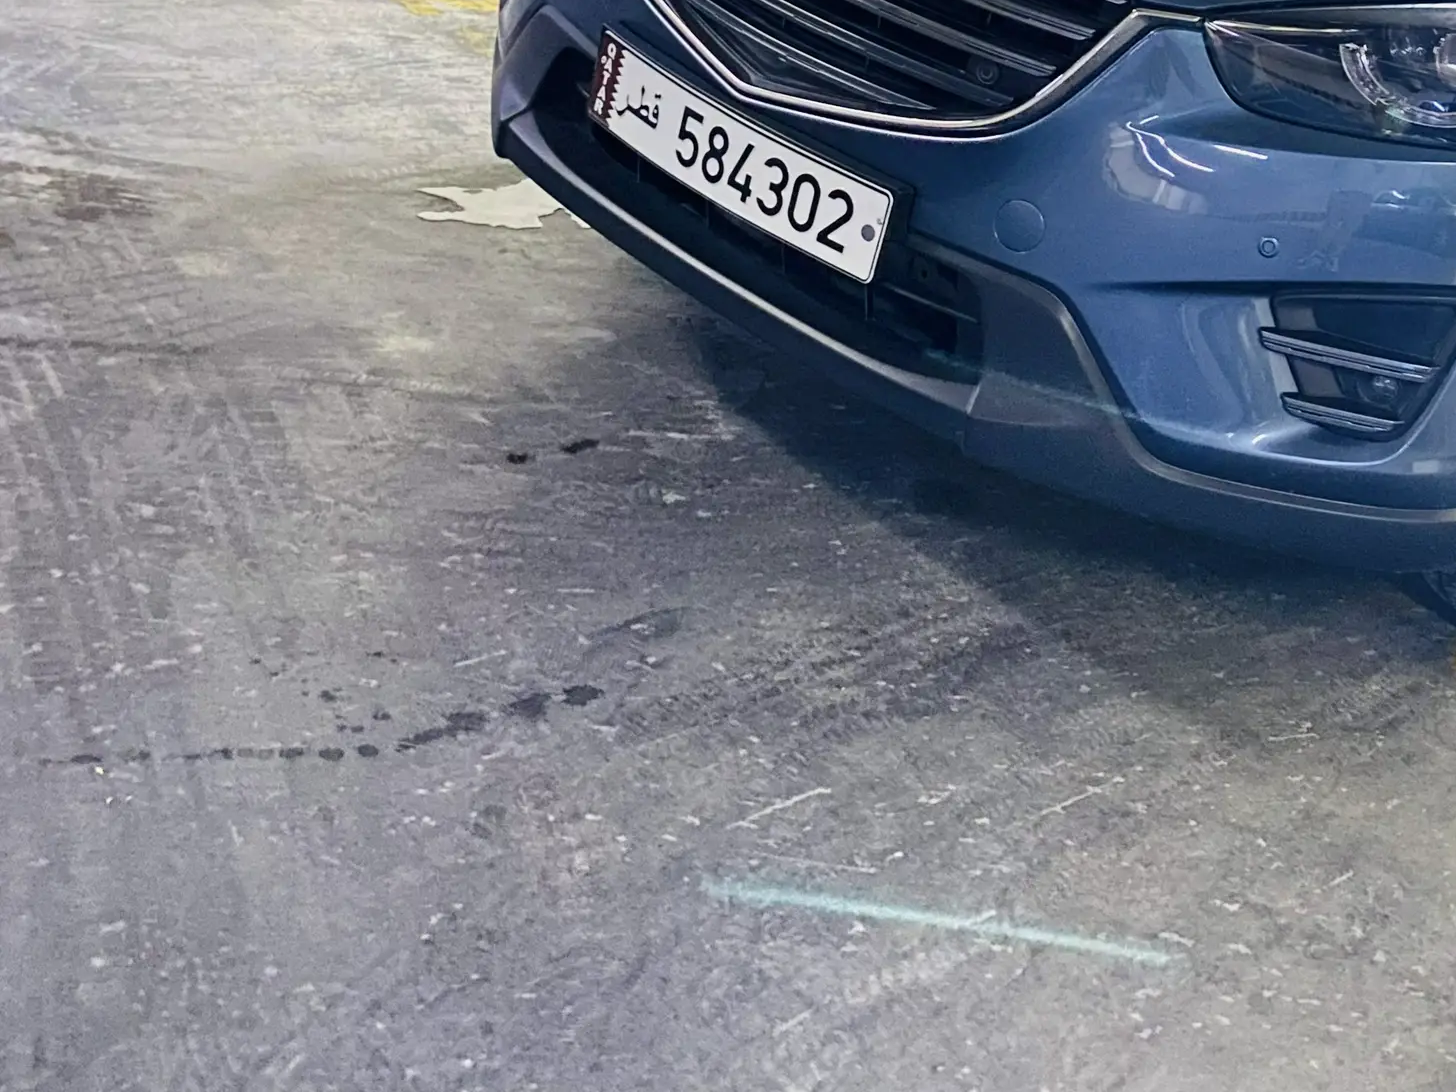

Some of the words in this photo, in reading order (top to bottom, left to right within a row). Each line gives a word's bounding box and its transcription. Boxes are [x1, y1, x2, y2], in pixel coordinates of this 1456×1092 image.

[593, 42, 616, 115] QATAR
[615, 85, 662, 129] قطر
[675, 105, 854, 254] 584302
